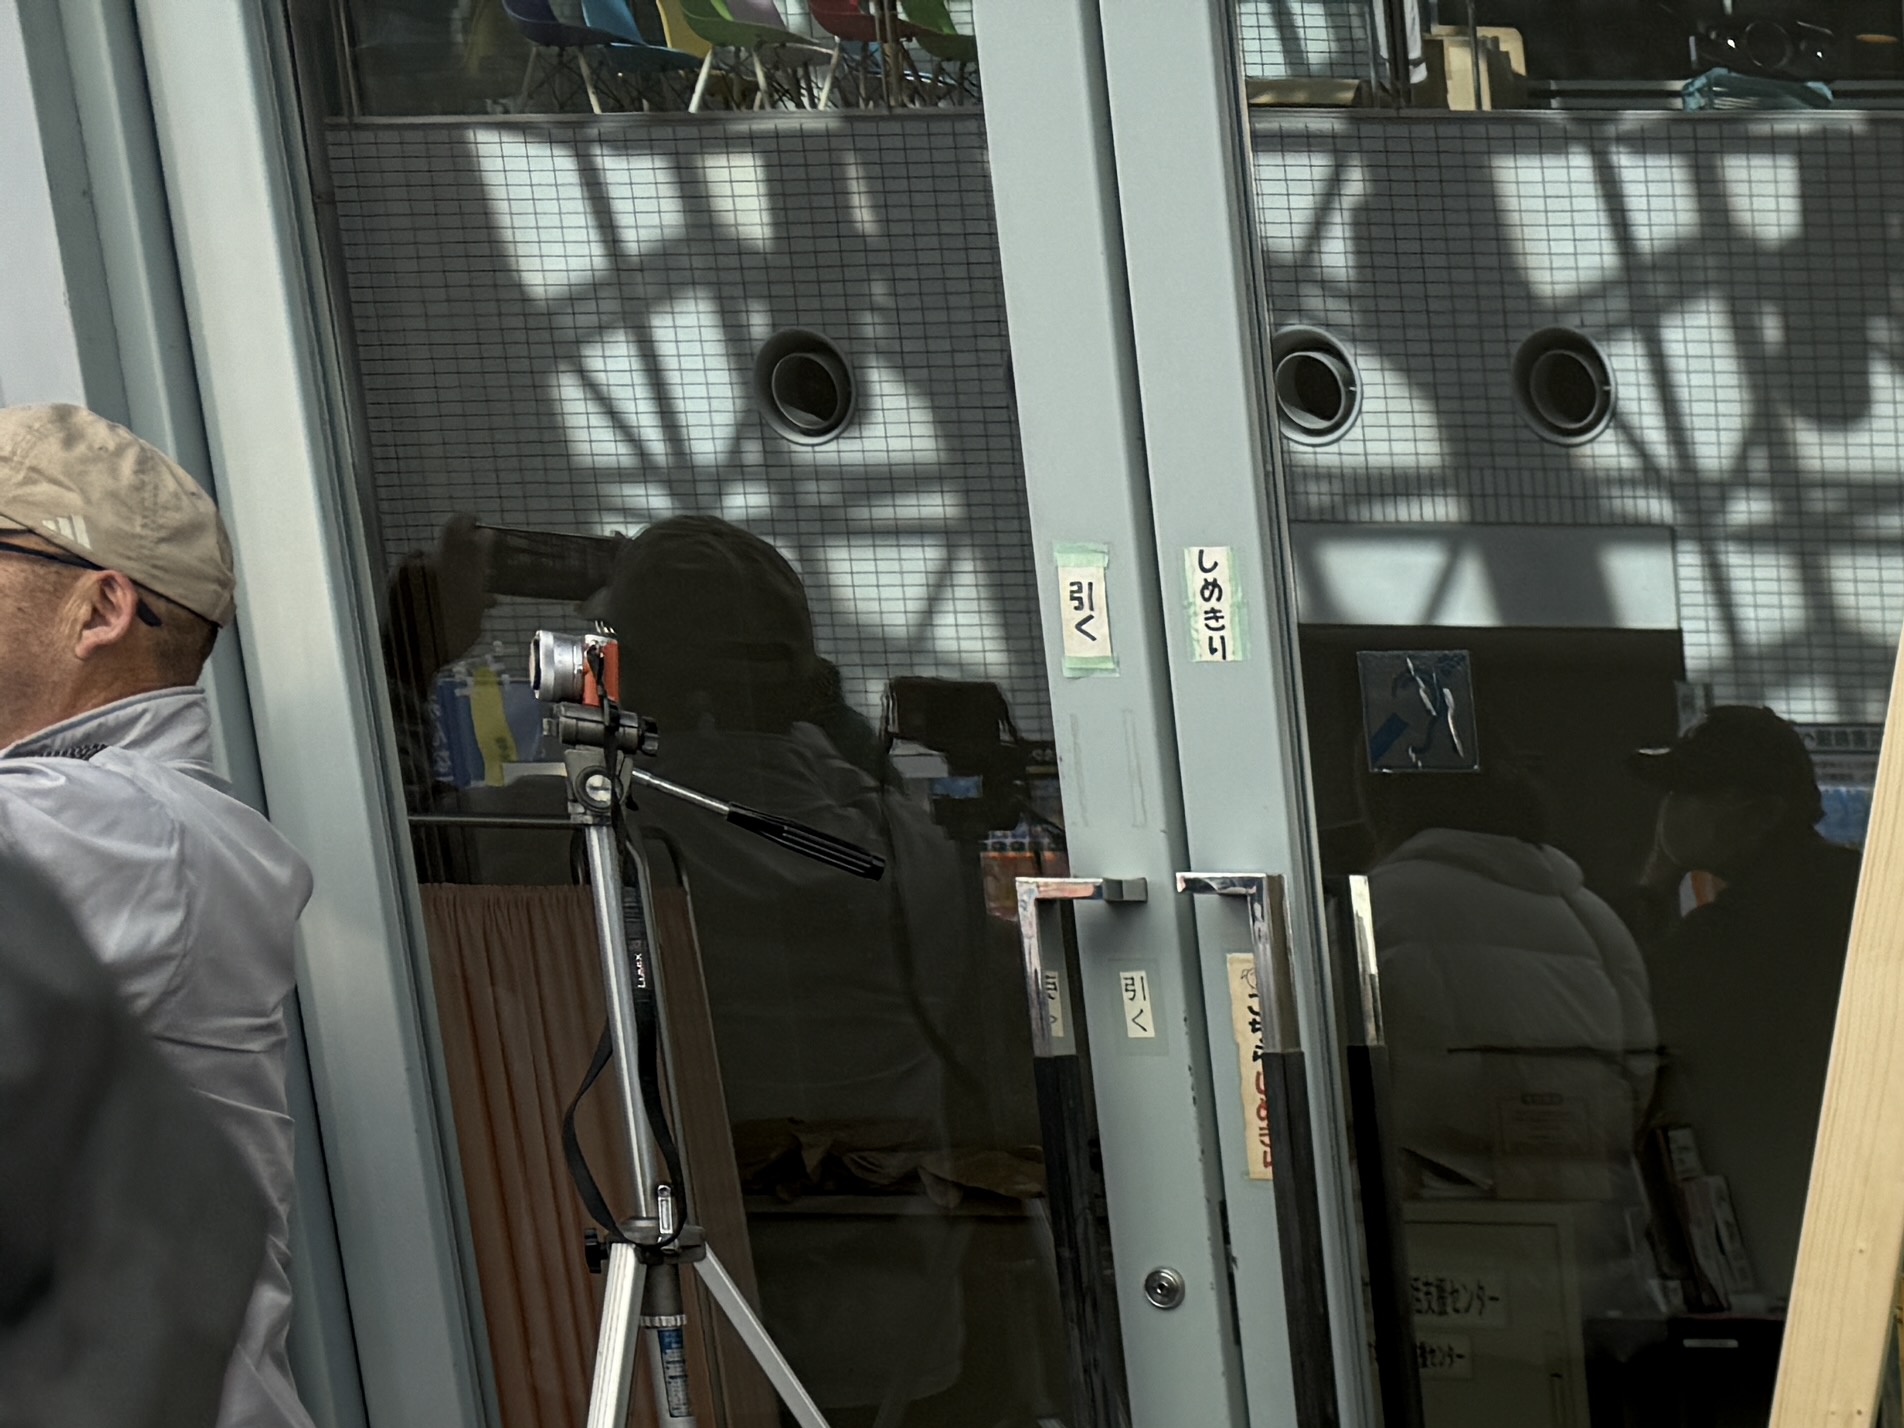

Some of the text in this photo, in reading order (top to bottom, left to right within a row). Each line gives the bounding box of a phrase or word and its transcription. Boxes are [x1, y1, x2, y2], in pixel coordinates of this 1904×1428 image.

[1069, 580, 1097, 642] 引く
[1196, 549, 1227, 661] しめきり
[1124, 974, 1149, 1033] 引く
